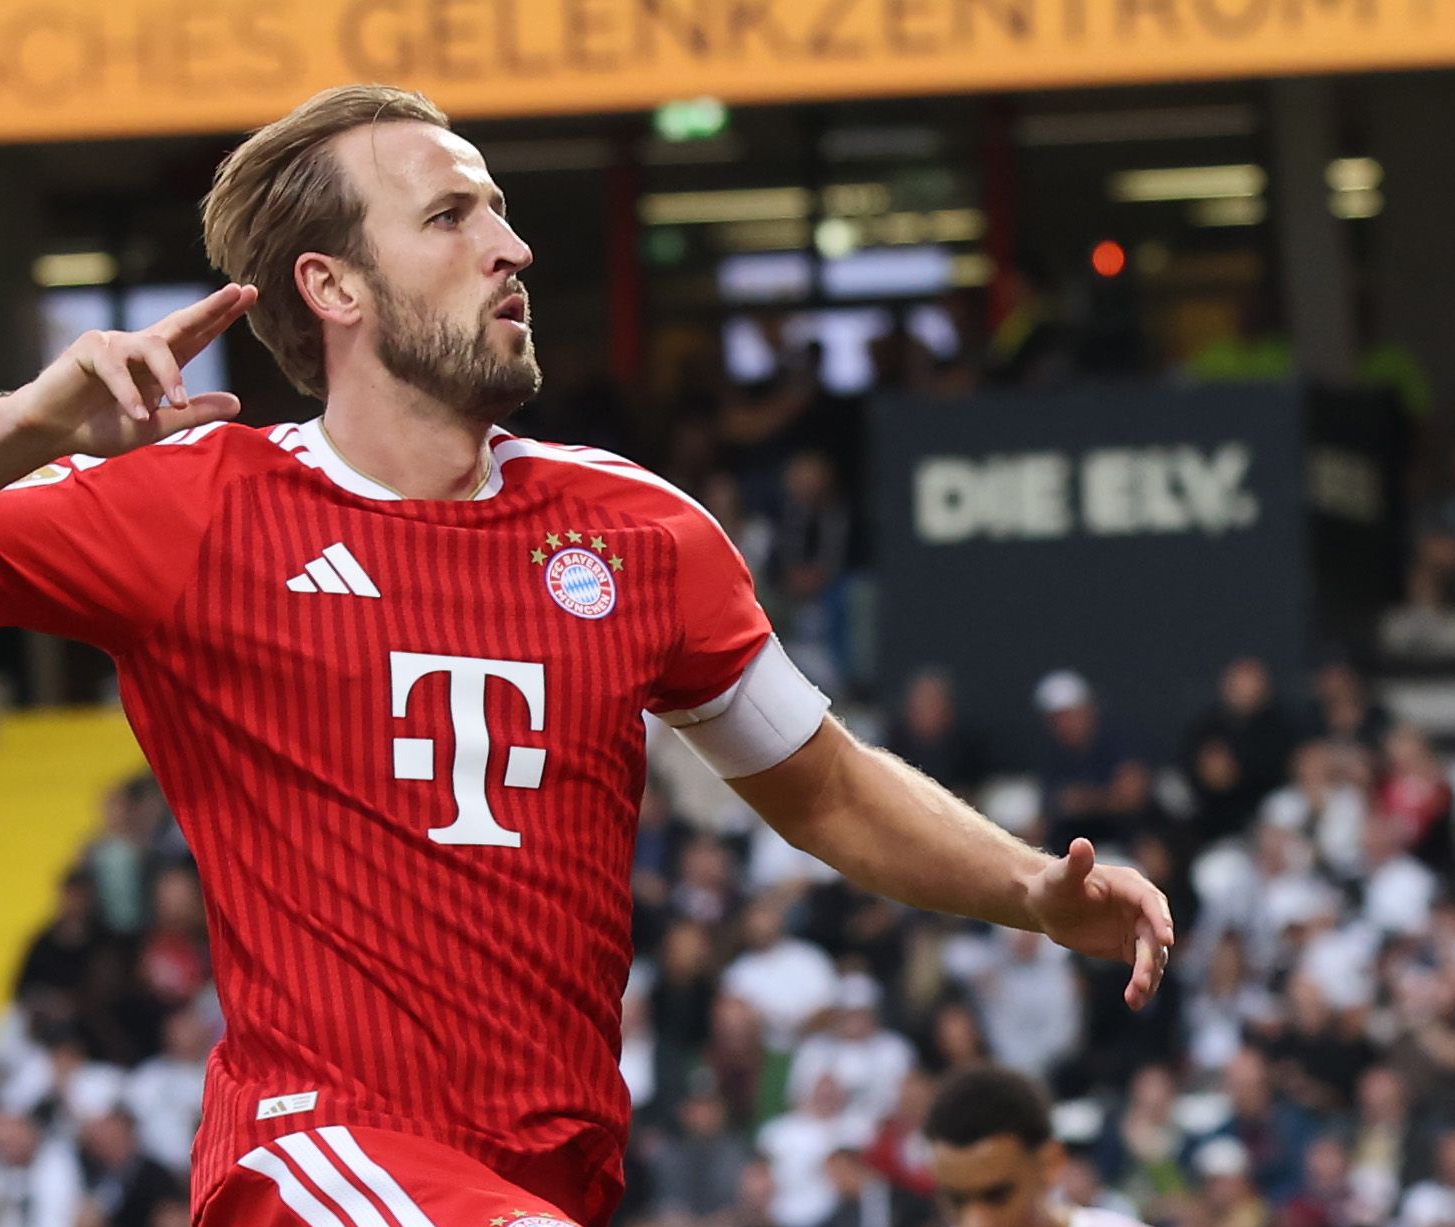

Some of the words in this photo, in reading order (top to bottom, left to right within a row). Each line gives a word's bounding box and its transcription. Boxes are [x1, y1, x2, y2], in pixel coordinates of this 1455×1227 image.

[916, 454, 1069, 544] DIE
[550, 561, 564, 579] FC
[562, 553, 608, 583] BAYERN
[389, 650, 547, 849] T
